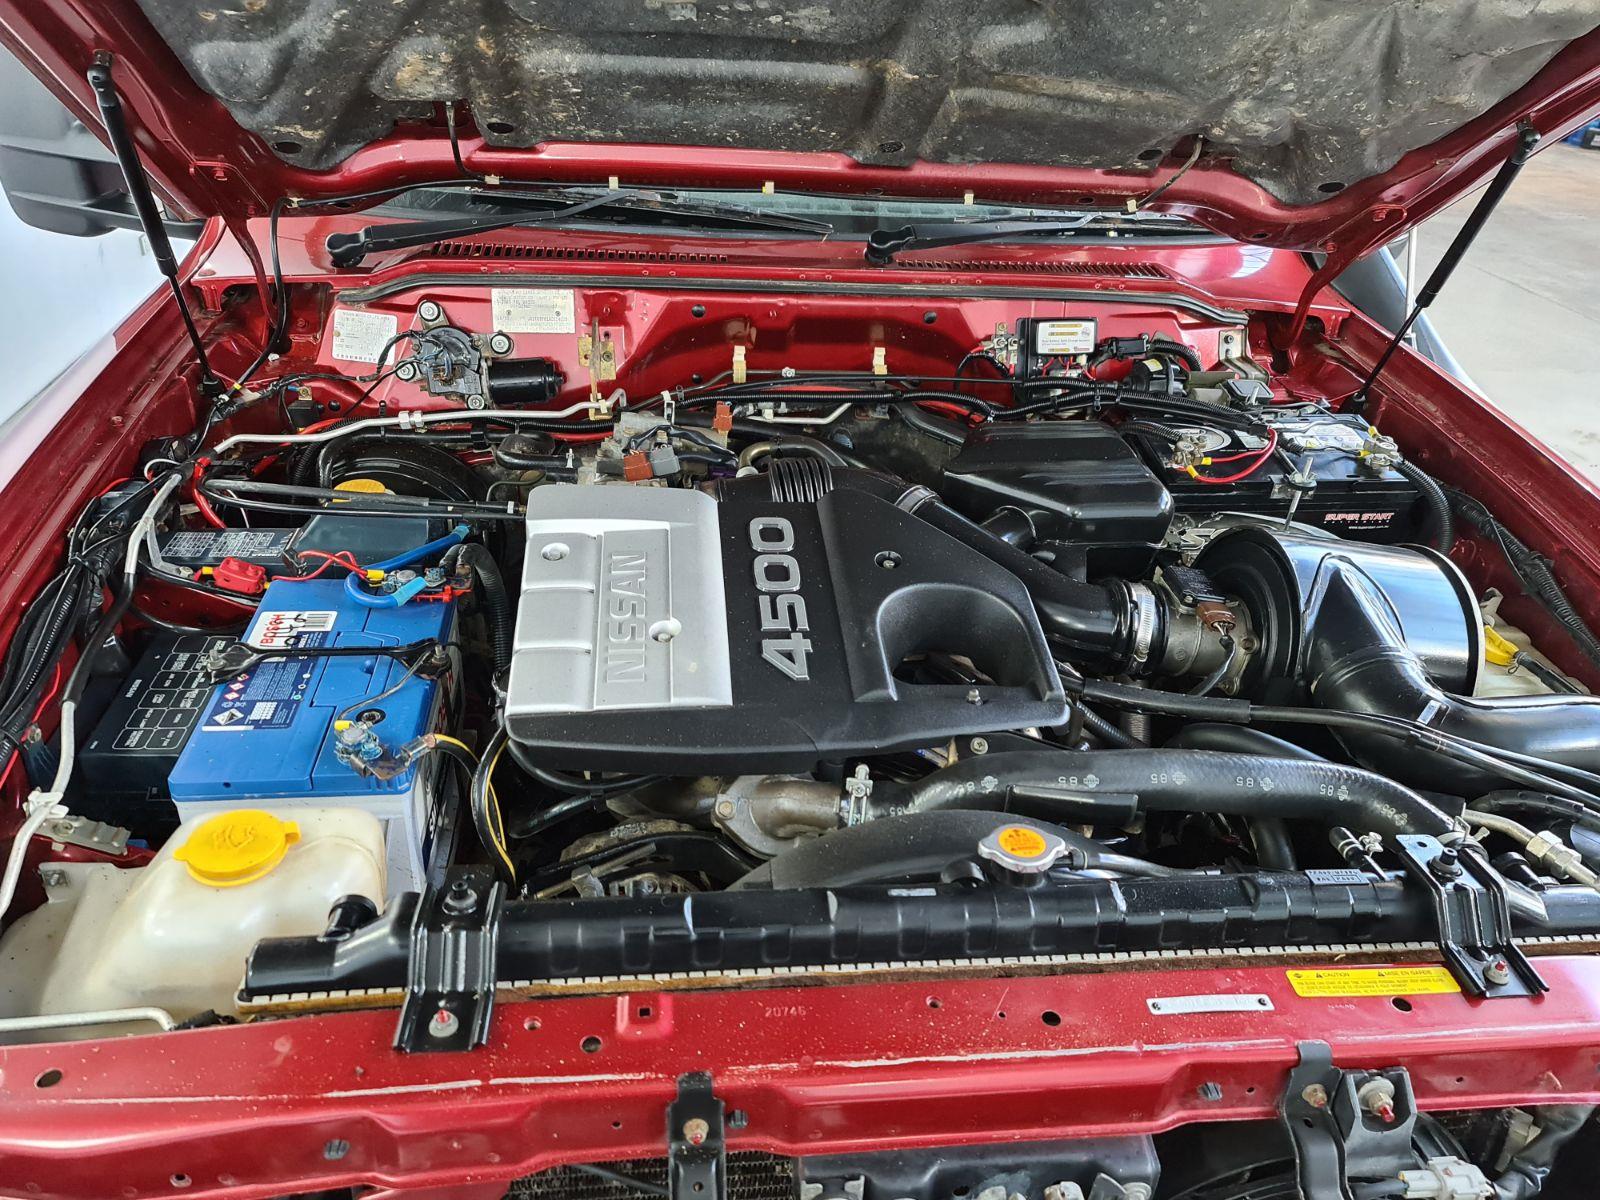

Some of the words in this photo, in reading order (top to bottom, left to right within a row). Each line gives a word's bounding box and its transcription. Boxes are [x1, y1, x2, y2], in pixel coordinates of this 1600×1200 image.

[1361, 512, 1394, 520] START
[749, 516, 813, 681] 4500
[606, 551, 647, 683] NISSAN
[260, 614, 286, 645] BOSCH
[1058, 776, 1078, 786] 85
[1150, 773, 1168, 784] 85
[1236, 775, 1254, 788] 85
[1319, 784, 1334, 796] 85
